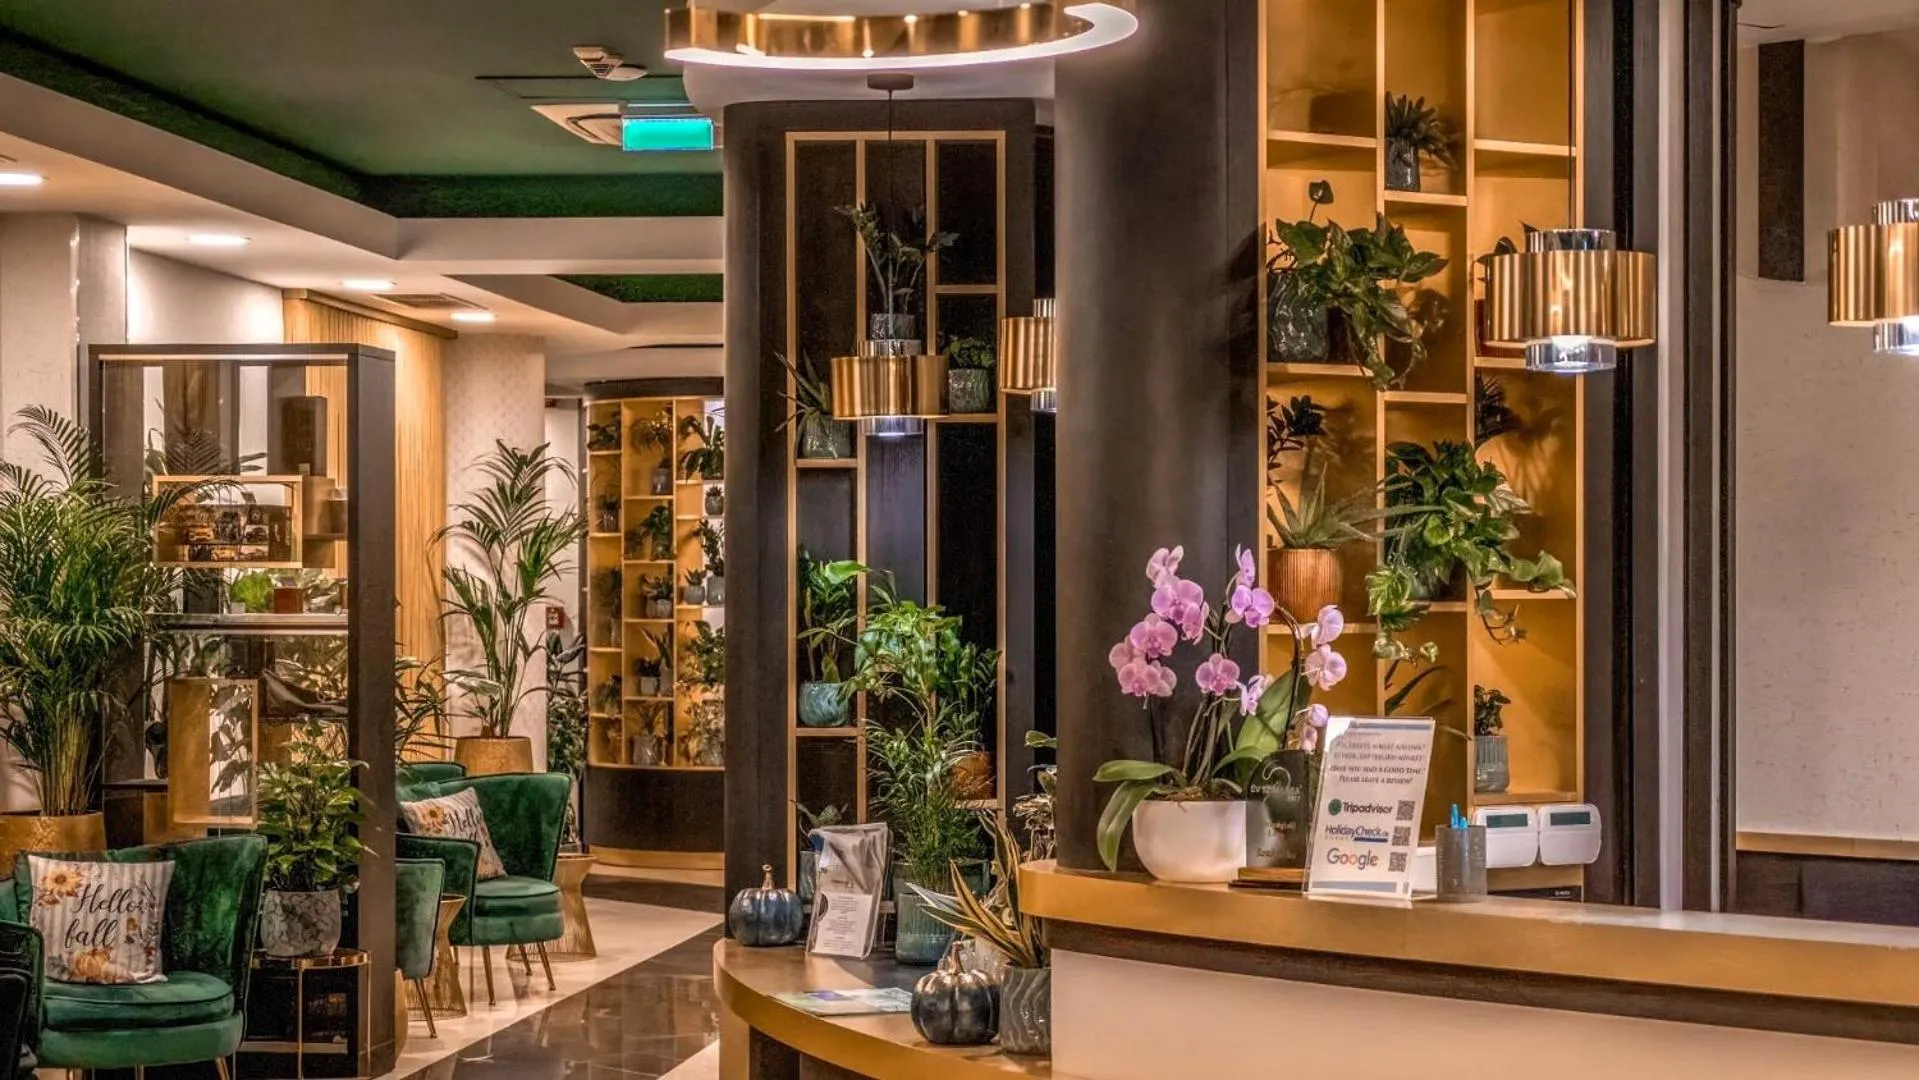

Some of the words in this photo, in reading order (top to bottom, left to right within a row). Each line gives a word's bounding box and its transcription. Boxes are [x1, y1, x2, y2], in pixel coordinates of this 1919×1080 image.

[1343, 801, 1393, 815] Tripadvisor
[1327, 847, 1379, 870] Google
[72, 884, 142, 914] Hello
[64, 918, 119, 949] fall
